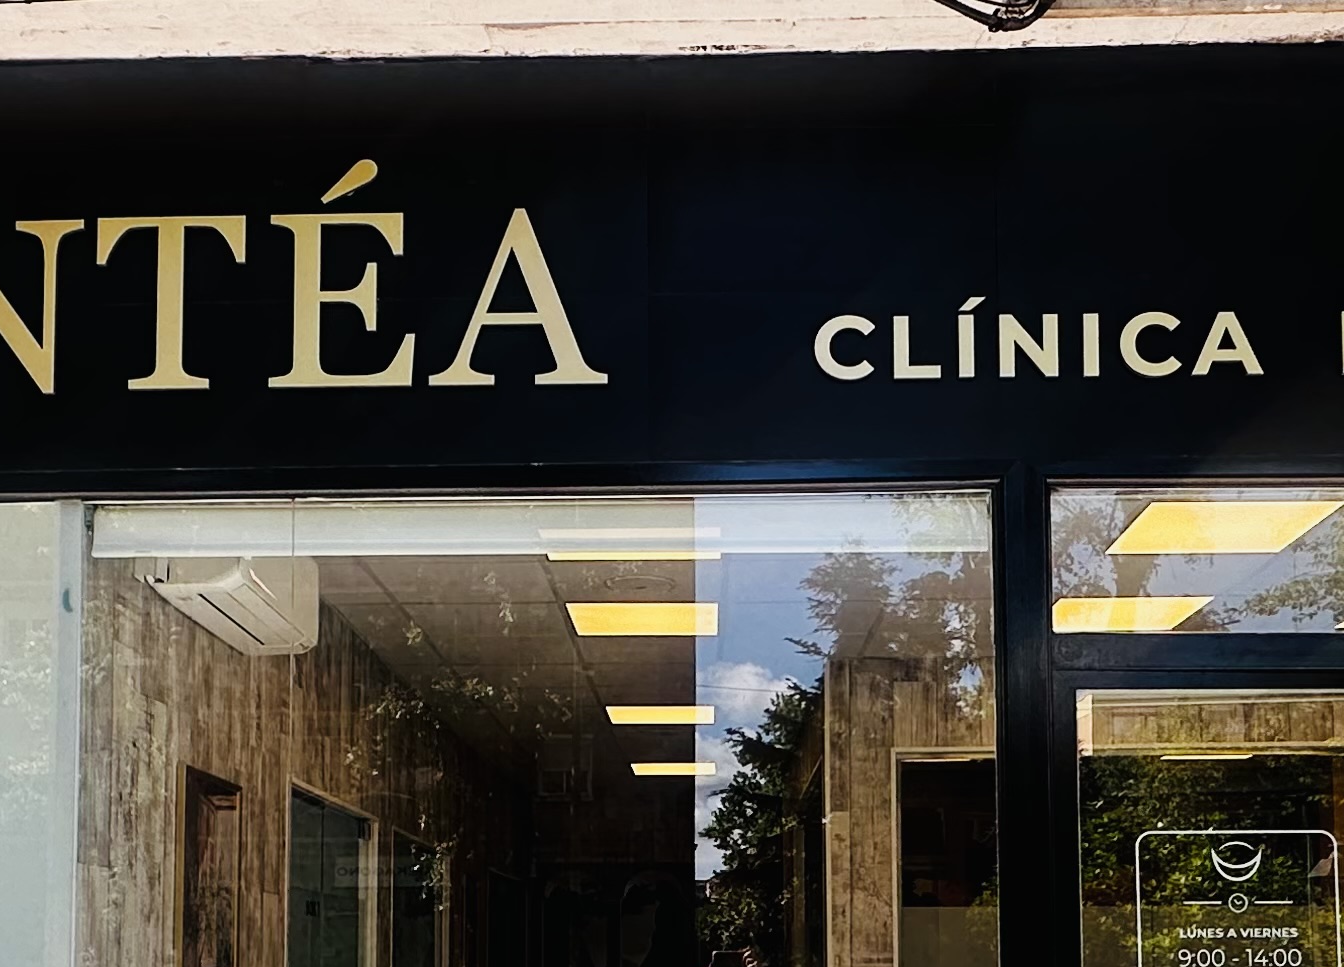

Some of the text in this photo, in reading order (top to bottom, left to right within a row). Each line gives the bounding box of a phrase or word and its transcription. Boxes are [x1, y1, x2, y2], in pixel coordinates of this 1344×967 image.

[813, 297, 1265, 381] CLÍNICA
[1226, 928, 1237, 938] A
[1240, 927, 1299, 938] VIERNES
[1178, 949, 1226, 967] 9:00
[1245, 948, 1303, 967] 14:00
